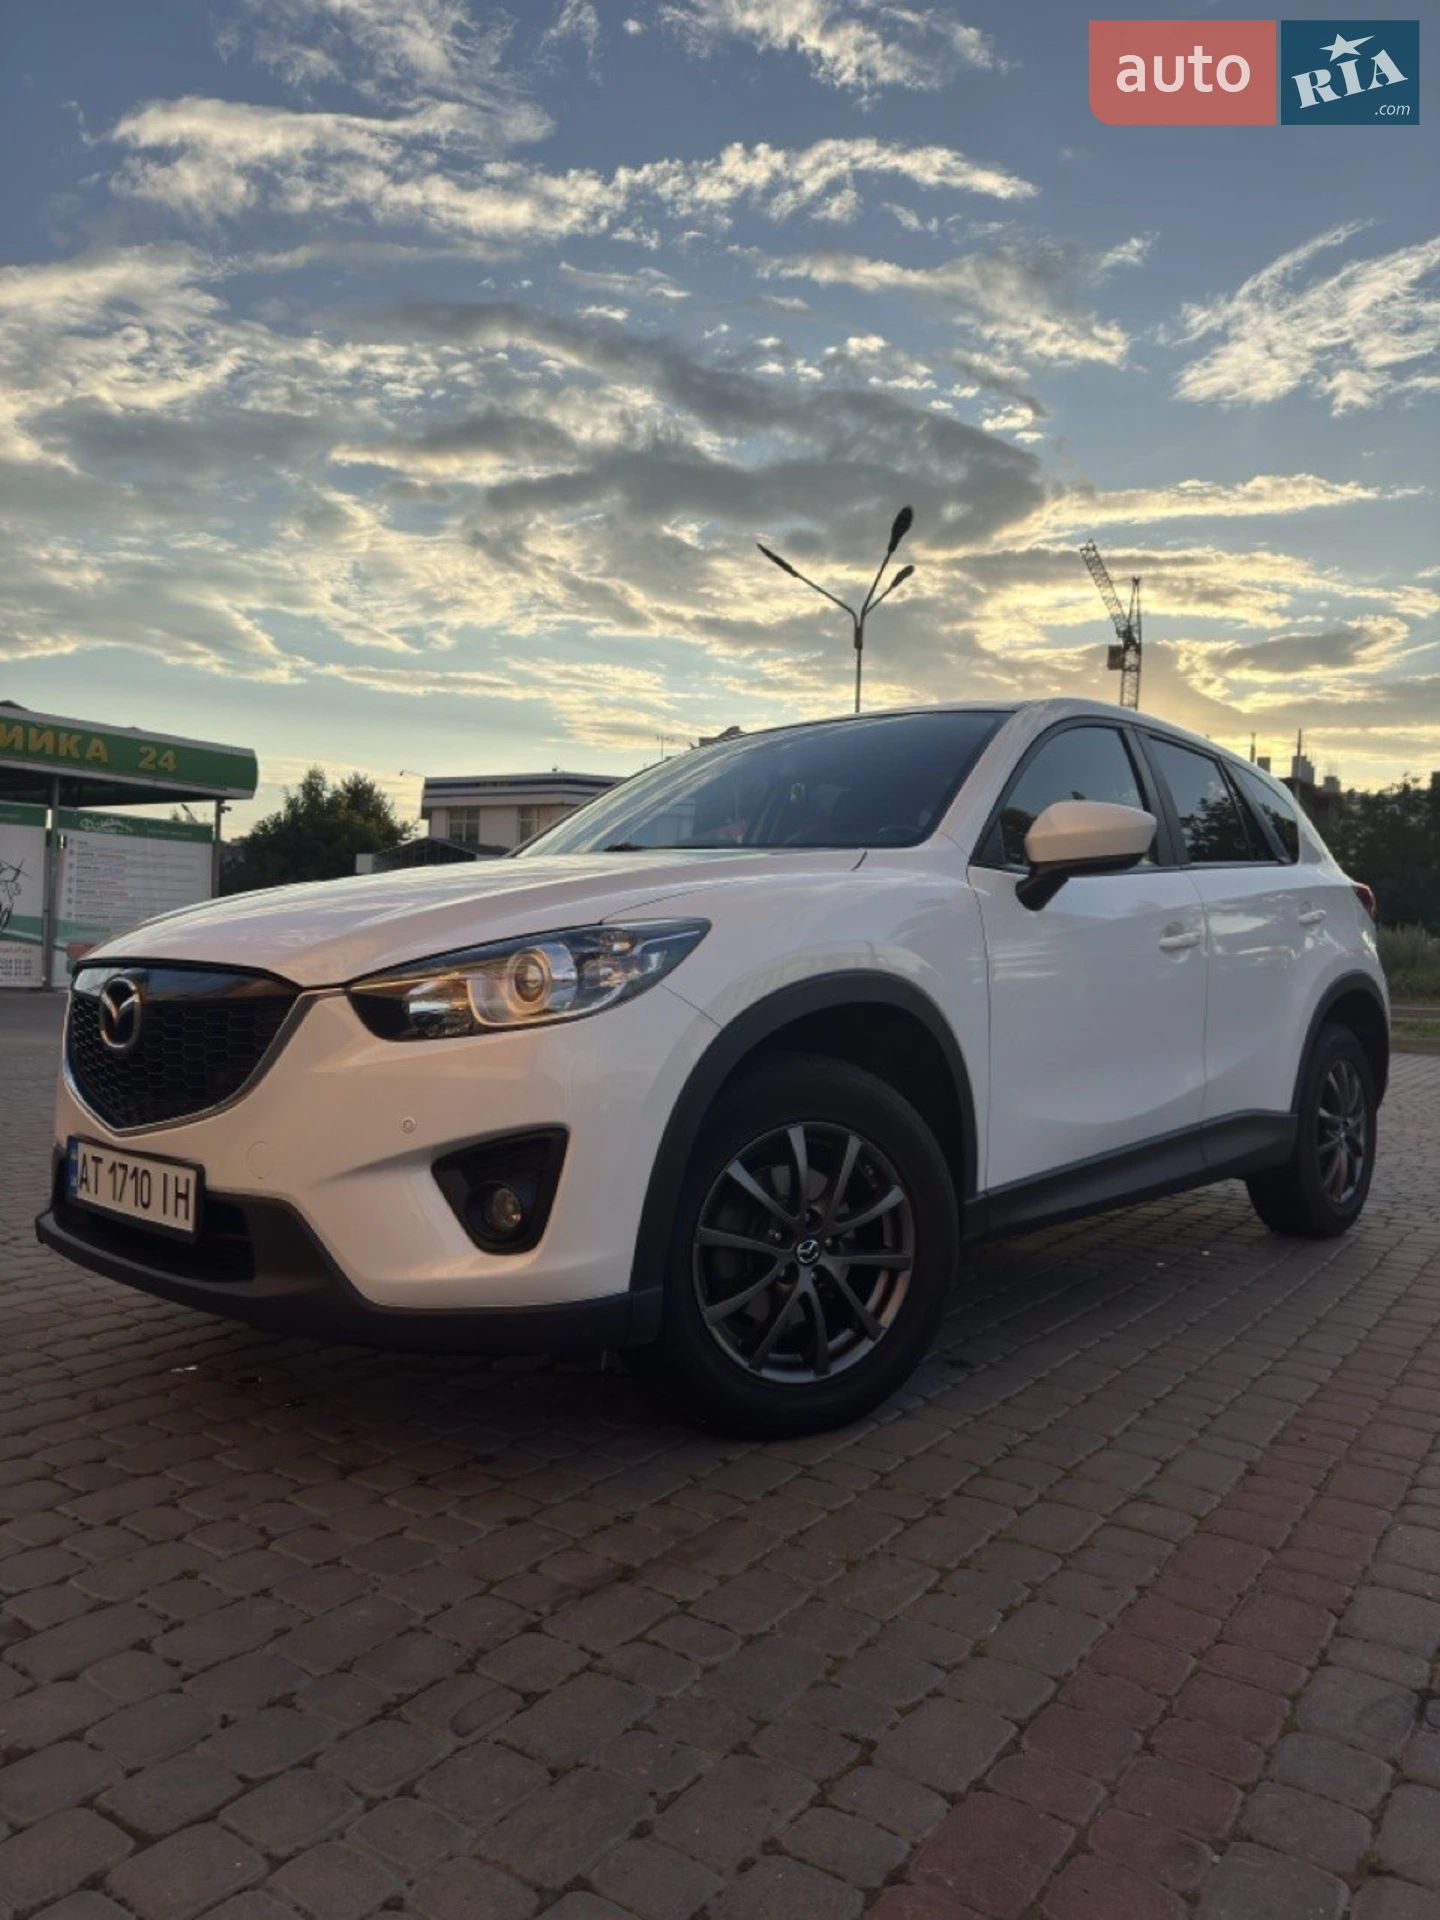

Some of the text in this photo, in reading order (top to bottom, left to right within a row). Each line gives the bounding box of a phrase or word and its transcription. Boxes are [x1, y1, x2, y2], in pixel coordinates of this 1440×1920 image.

[137, 746, 178, 772] 24
[78, 1153, 190, 1220] AT 1710 IH
